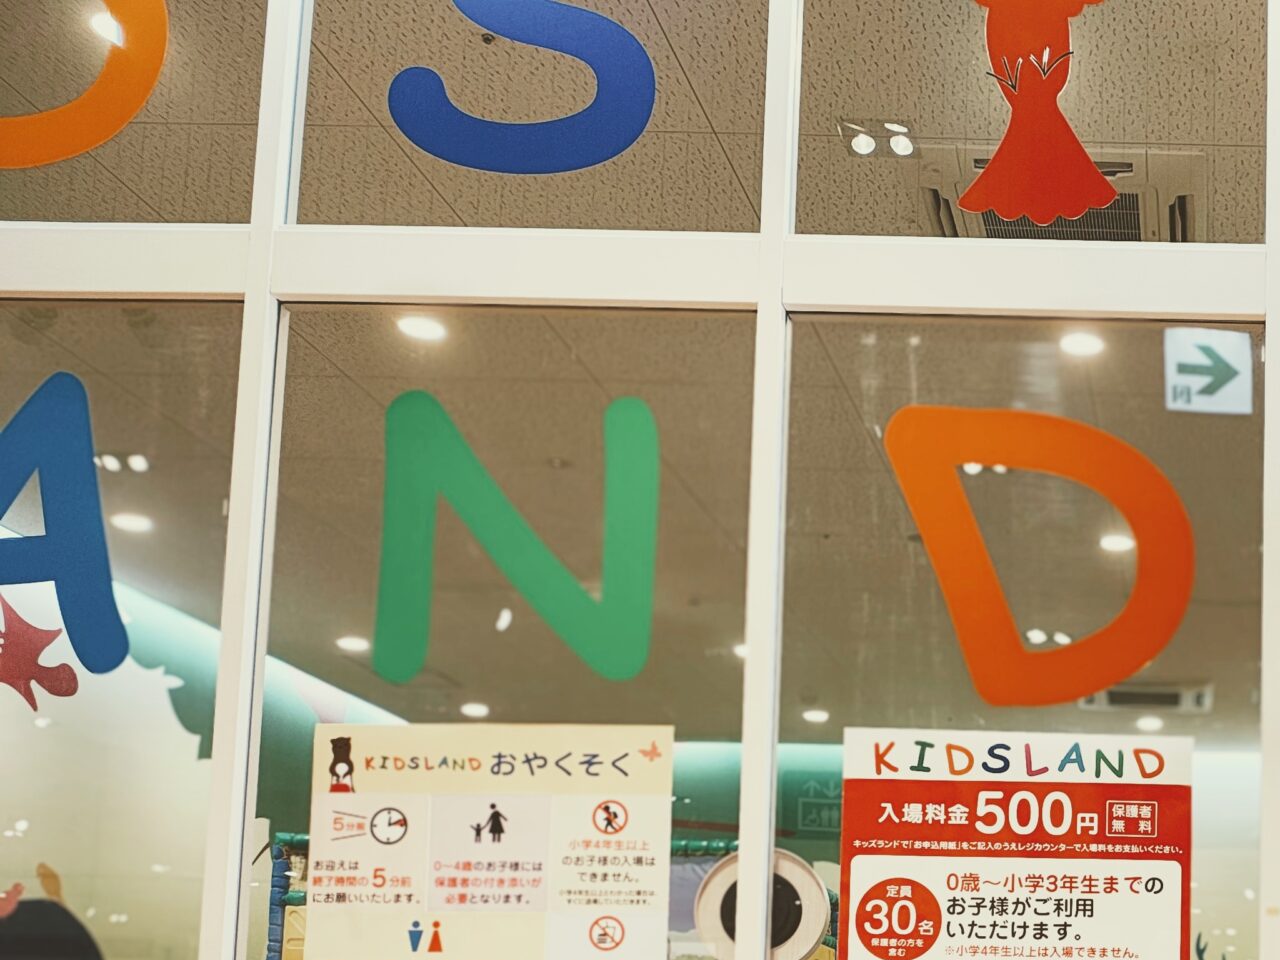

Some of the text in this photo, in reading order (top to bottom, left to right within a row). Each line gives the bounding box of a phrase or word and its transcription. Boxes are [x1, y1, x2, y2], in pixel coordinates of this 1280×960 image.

[364, 752, 631, 777] KIDSLAND おやくそく
[874, 740, 1165, 779] KIDSLAND
[1111, 804, 1152, 818] 保護者
[569, 839, 649, 851] 小学4年生以上
[313, 861, 359, 871] お迎えは
[562, 855, 655, 867] のお子様の入場は
[435, 877, 542, 888] 保護者の付き添いが
[577, 871, 639, 883] できません。
[946, 872, 1163, 895] 0歳～小学3年生までの
[886, 885, 912, 898] 定員
[312, 893, 420, 904] にお願いいたします。
[445, 893, 530, 905] 必要となります。
[946, 897, 1094, 918] お子様がご利用
[863, 900, 934, 936] 30名
[946, 921, 1082, 941] いただけます。
[871, 938, 924, 948] 保護者の方を
[888, 948, 905, 957] 含む
